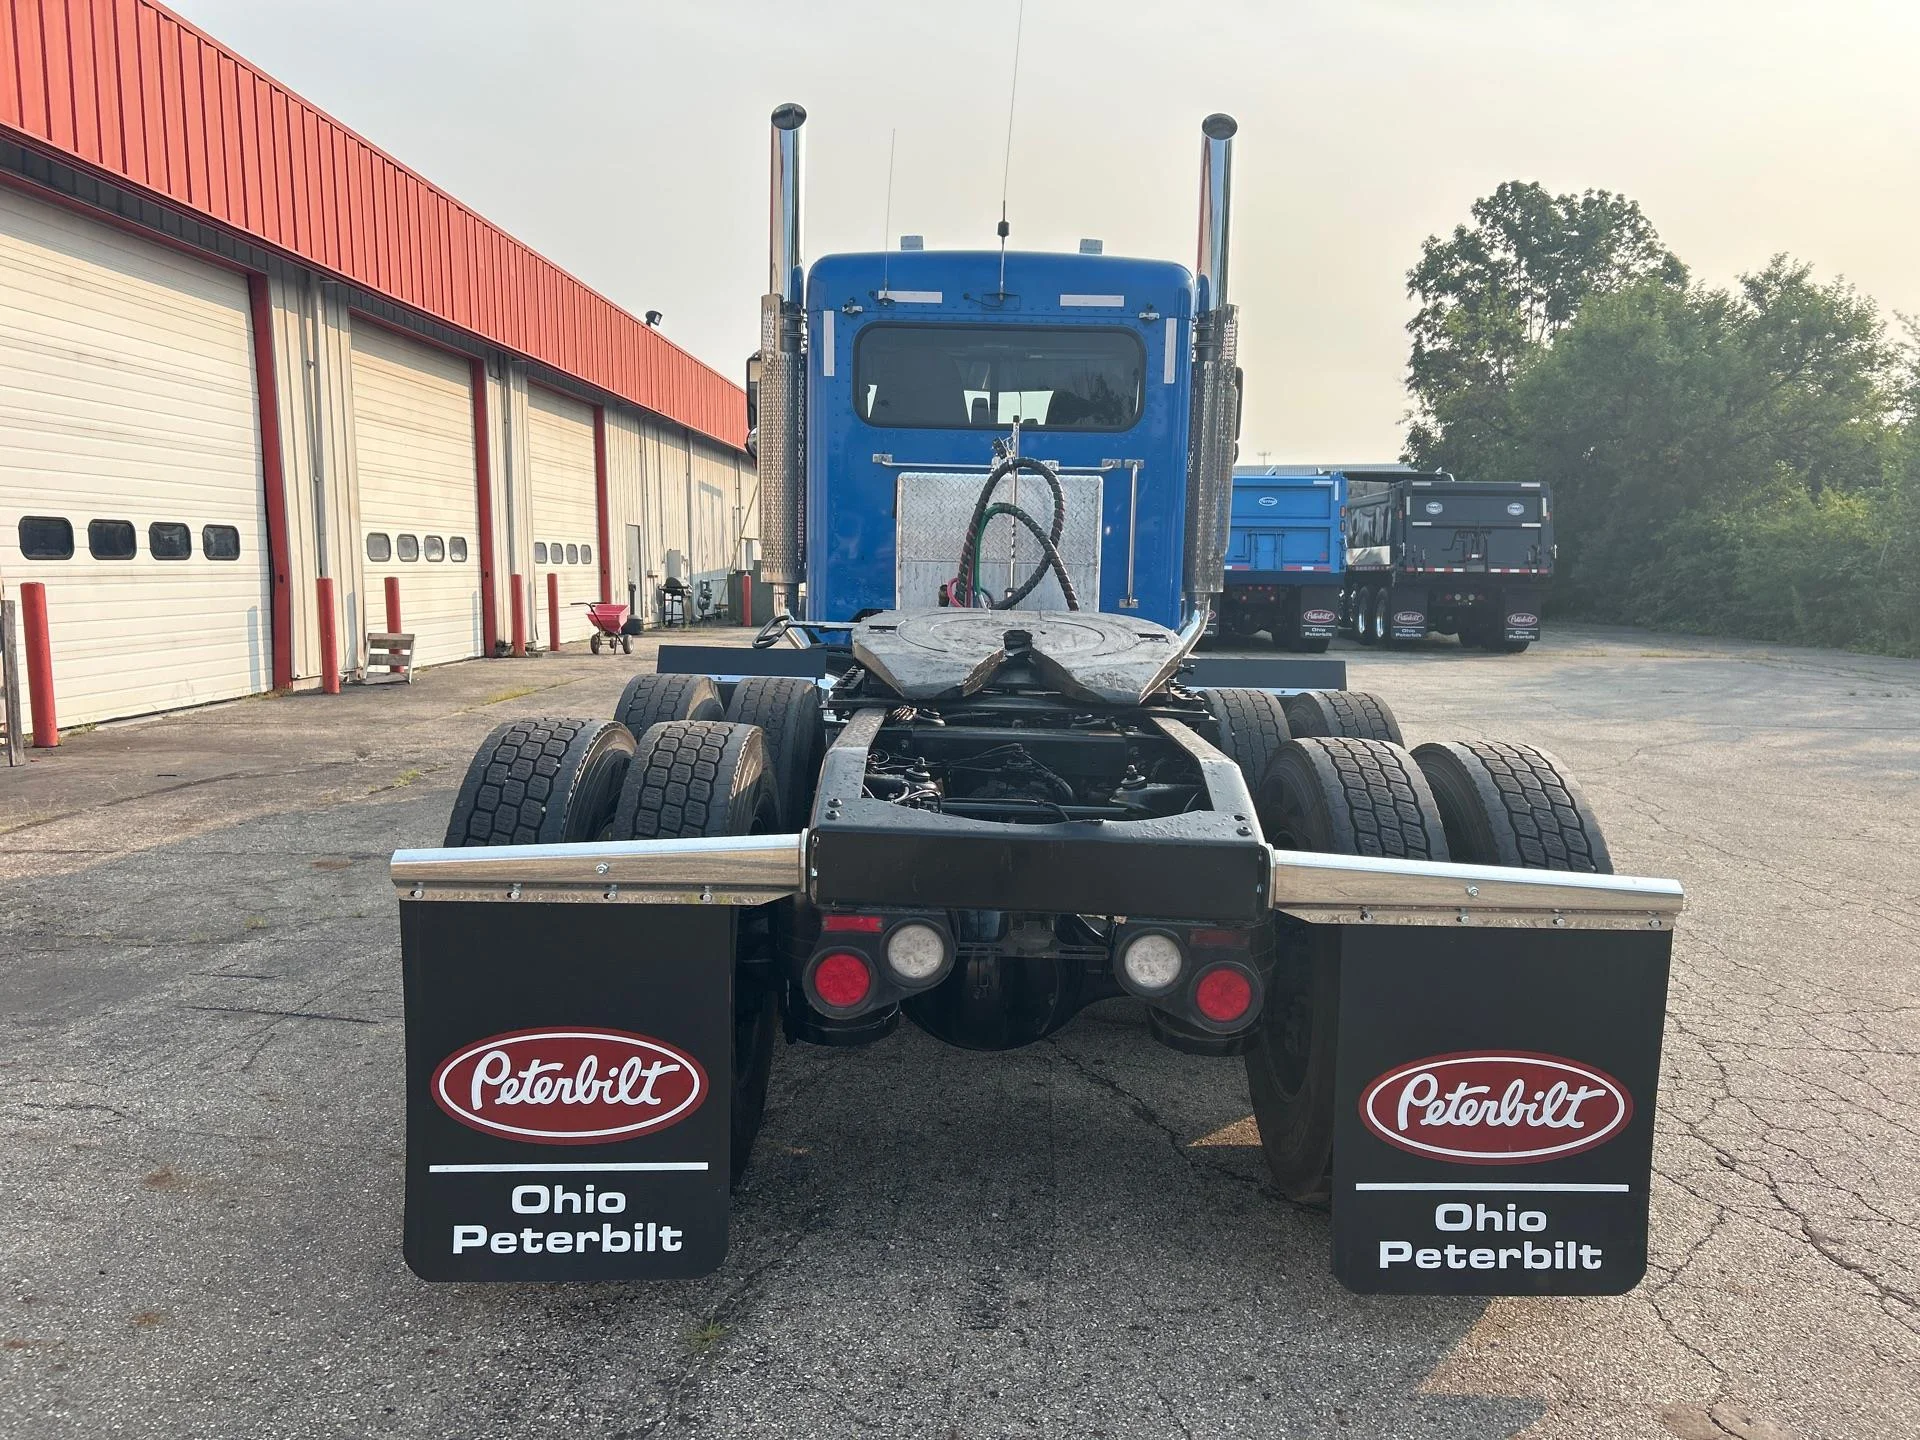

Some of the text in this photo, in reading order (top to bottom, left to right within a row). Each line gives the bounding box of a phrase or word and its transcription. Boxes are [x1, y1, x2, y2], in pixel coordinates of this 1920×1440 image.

[471, 1050, 681, 1111] Peterbilt
[1397, 1073, 1606, 1131] Peterbilt
[511, 1184, 627, 1214] Ohio
[1435, 1203, 1547, 1232] Ohio
[452, 1223, 683, 1254] Peterbilt
[1379, 1241, 1602, 1270] Peterbilt
